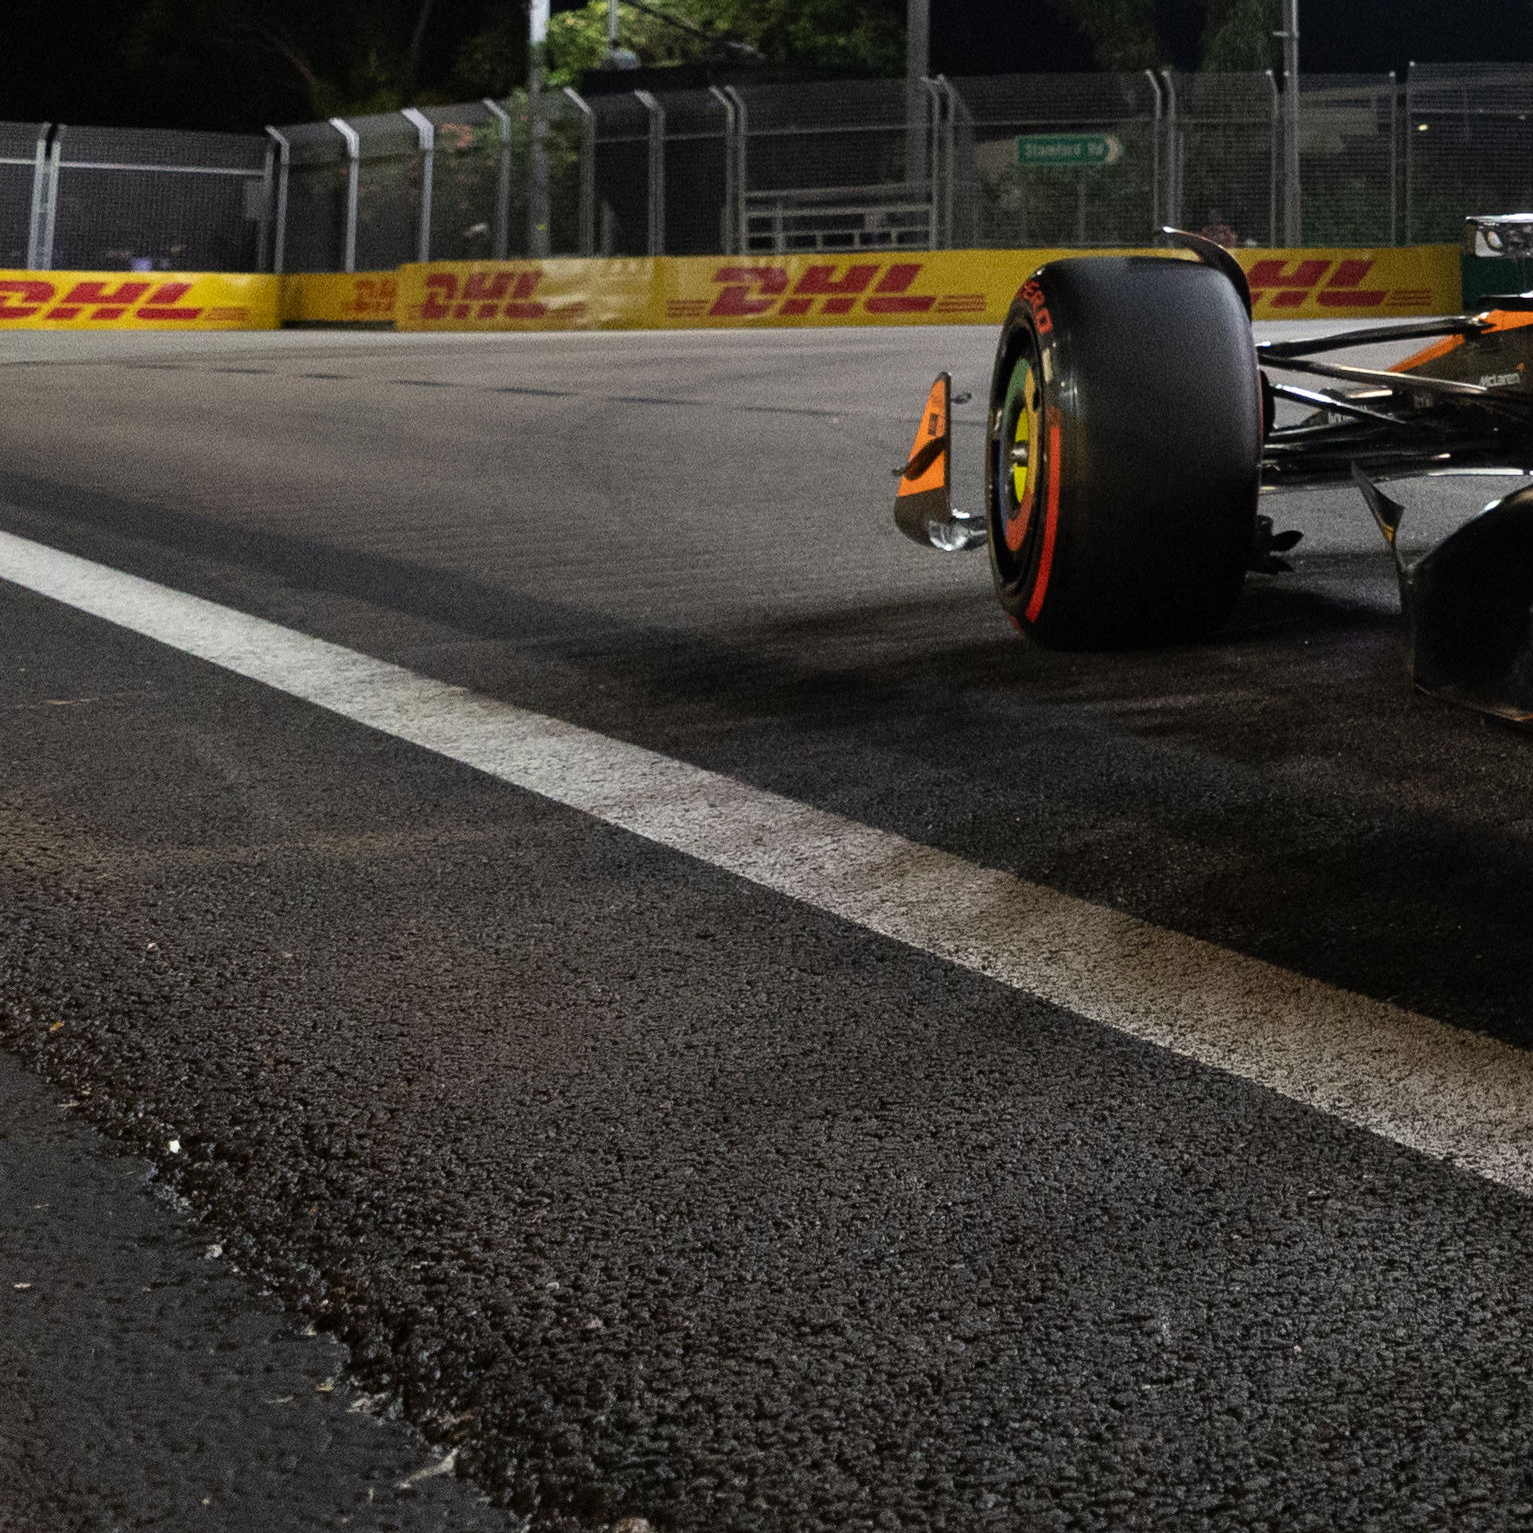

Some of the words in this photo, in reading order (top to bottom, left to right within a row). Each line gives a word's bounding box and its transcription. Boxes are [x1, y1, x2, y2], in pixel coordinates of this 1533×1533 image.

[421, 271, 545, 319] DHL
[709, 264, 936, 315] DHL
[1479, 373, 1521, 389] McLaren
